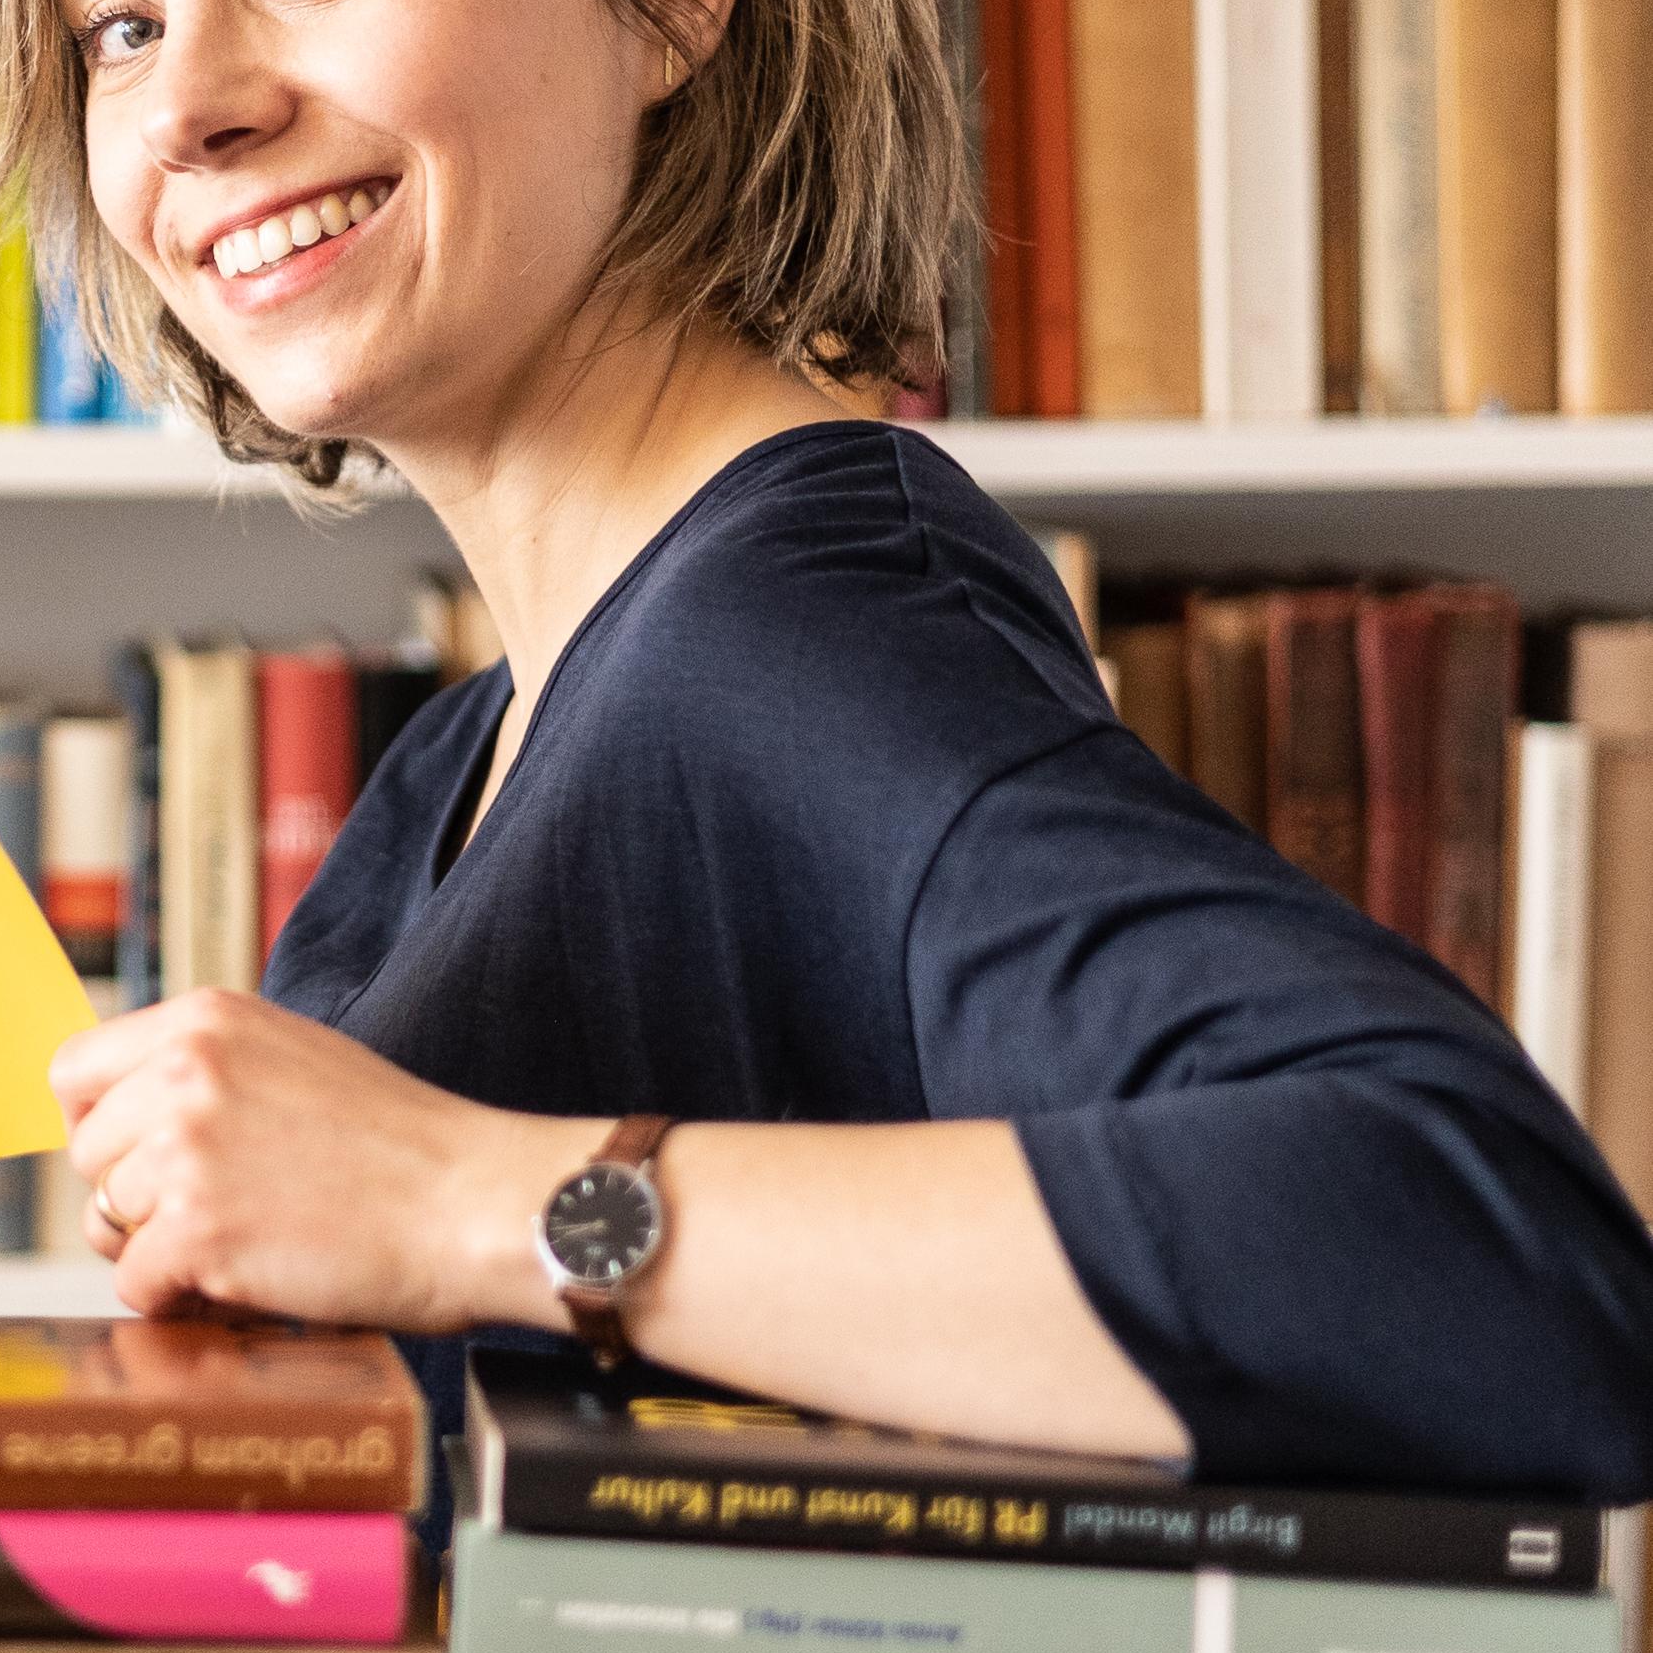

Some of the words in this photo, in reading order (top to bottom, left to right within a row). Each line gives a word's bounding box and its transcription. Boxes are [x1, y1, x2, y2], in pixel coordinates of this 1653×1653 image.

[5, 1424, 182, 1477] greene
[188, 1427, 395, 1493] graham
[589, 1473, 713, 1525] Kultur
[719, 1483, 801, 1529] und
[806, 1486, 917, 1536] Kunst
[924, 1494, 988, 1542] für
[994, 1498, 1049, 1546] PR
[1063, 1502, 1200, 1545] Mandel
[1204, 1507, 1302, 1553] Birgit
